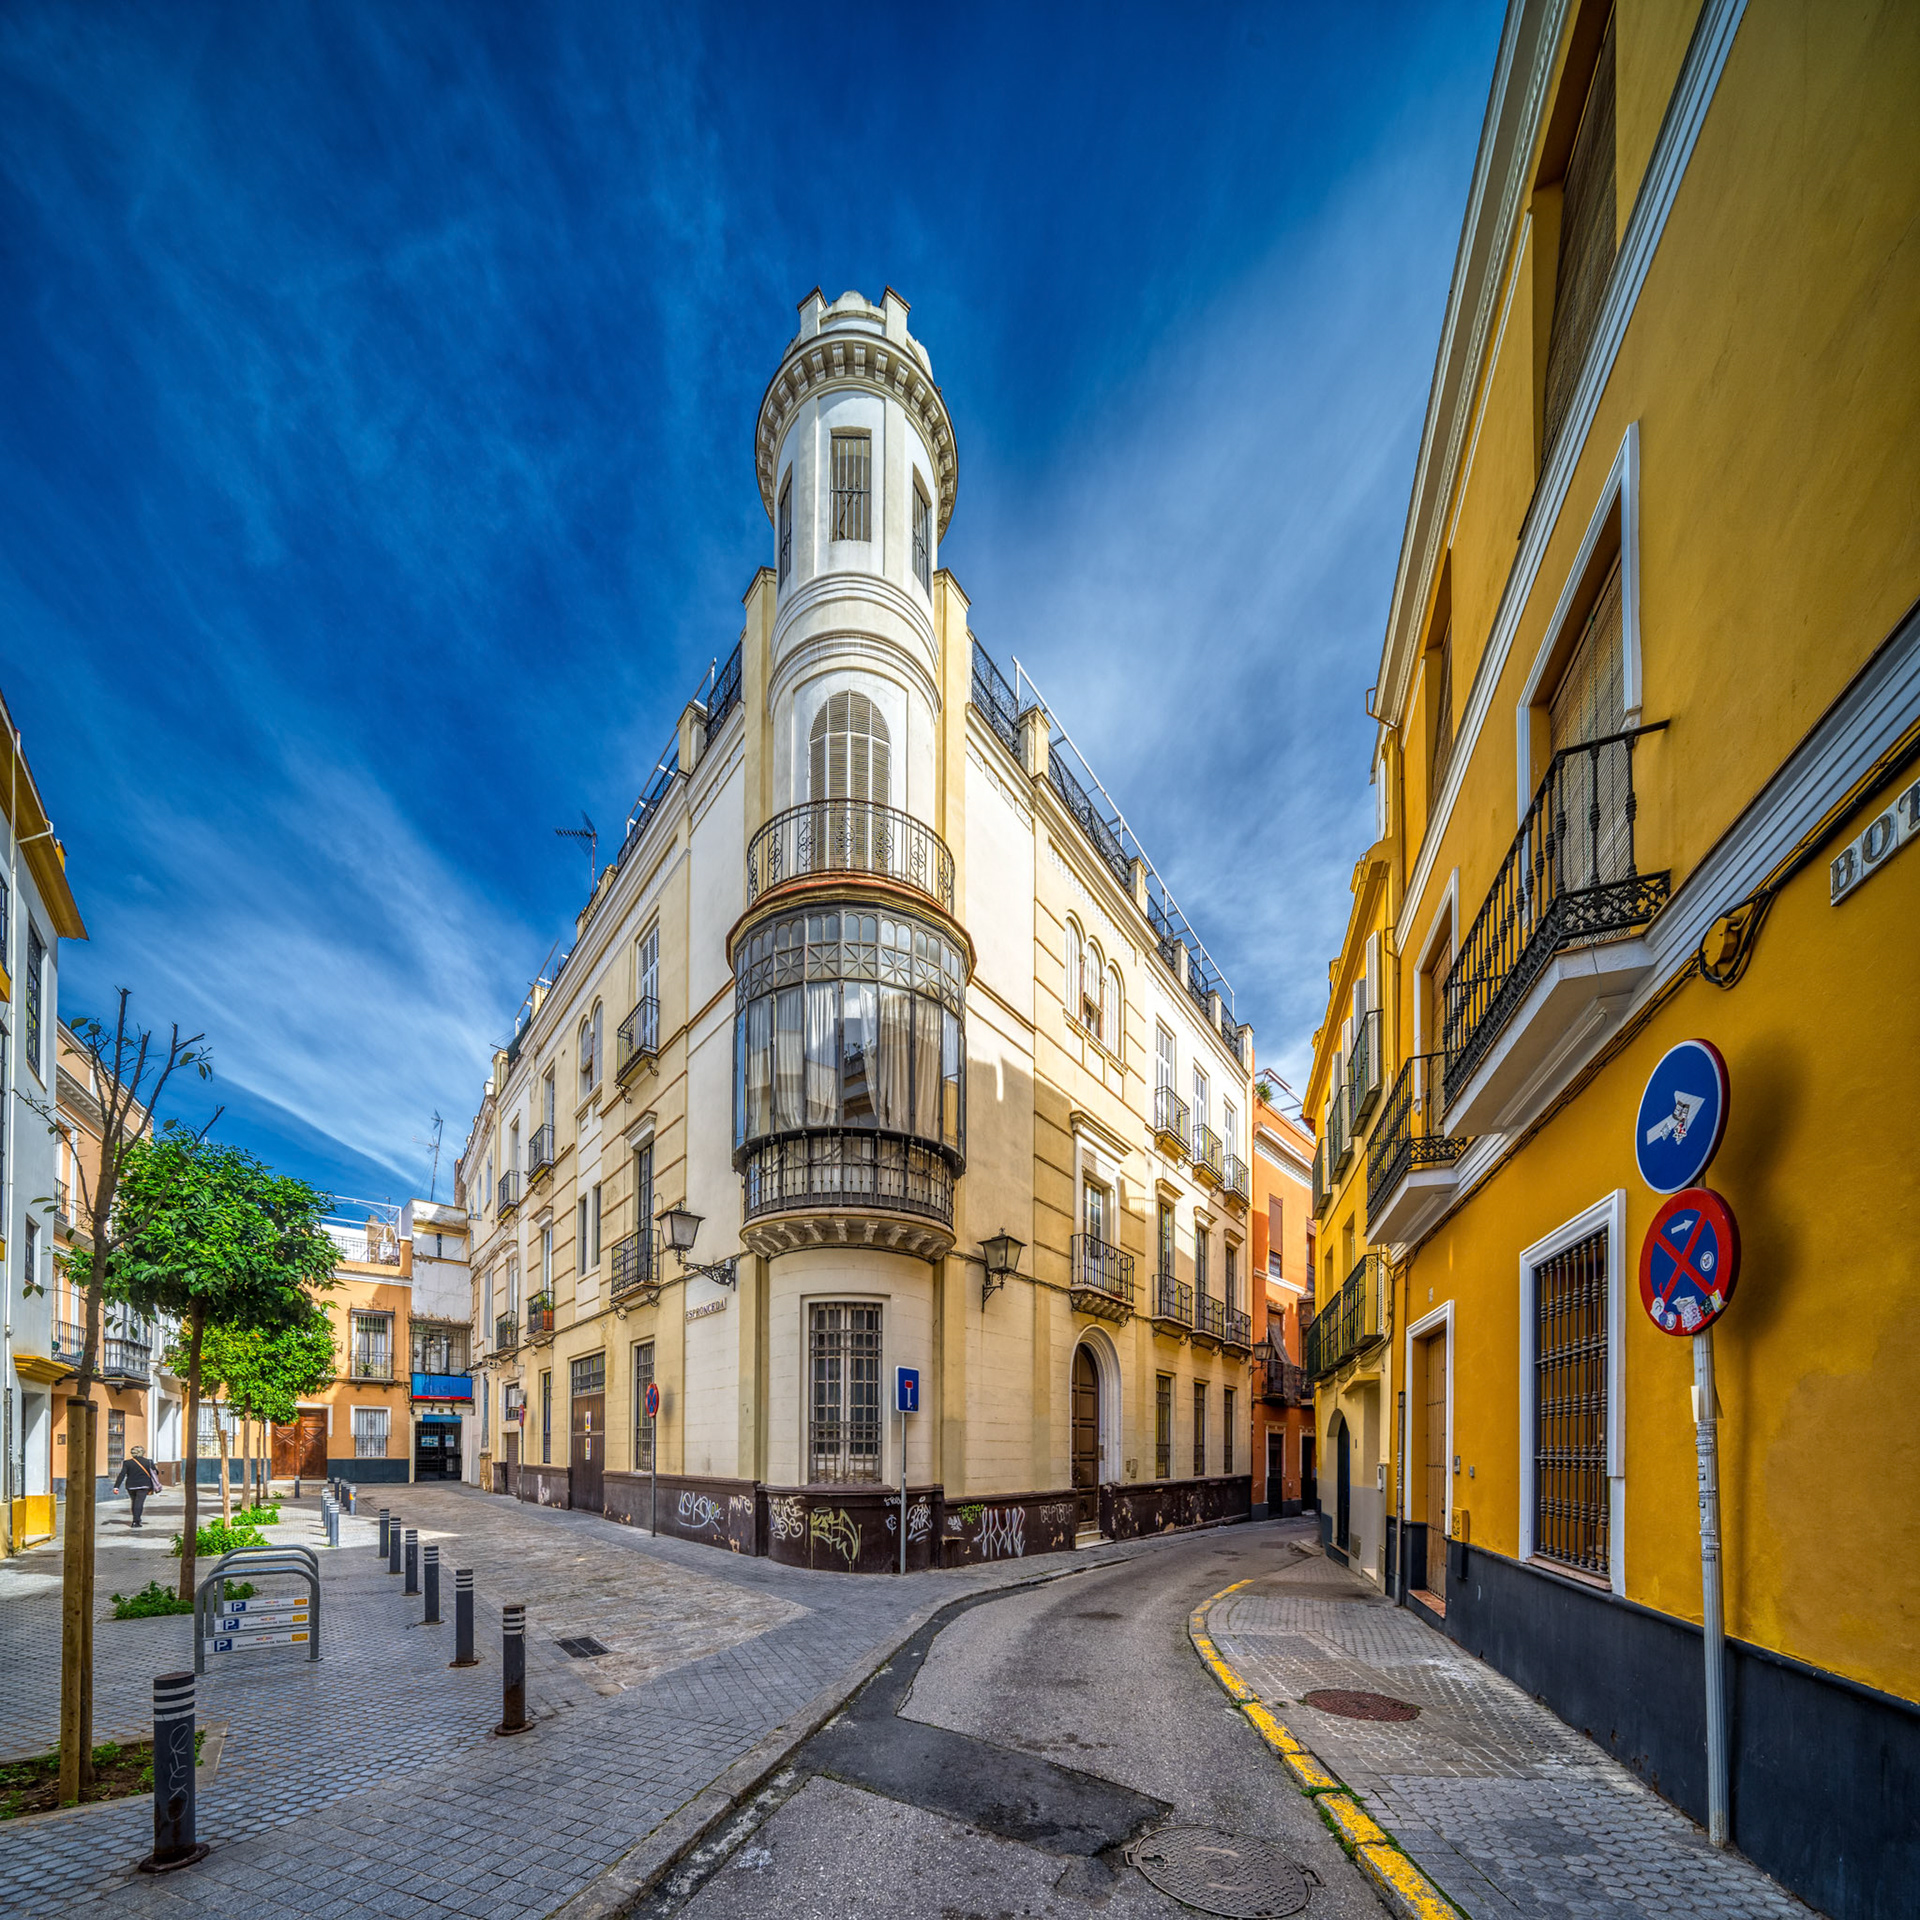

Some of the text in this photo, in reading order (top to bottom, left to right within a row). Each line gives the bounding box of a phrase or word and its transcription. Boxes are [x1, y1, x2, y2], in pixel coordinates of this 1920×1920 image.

[685, 1299, 724, 1319] ESPRONCEDA
[225, 1620, 235, 1630] P
[216, 1640, 228, 1651] P
